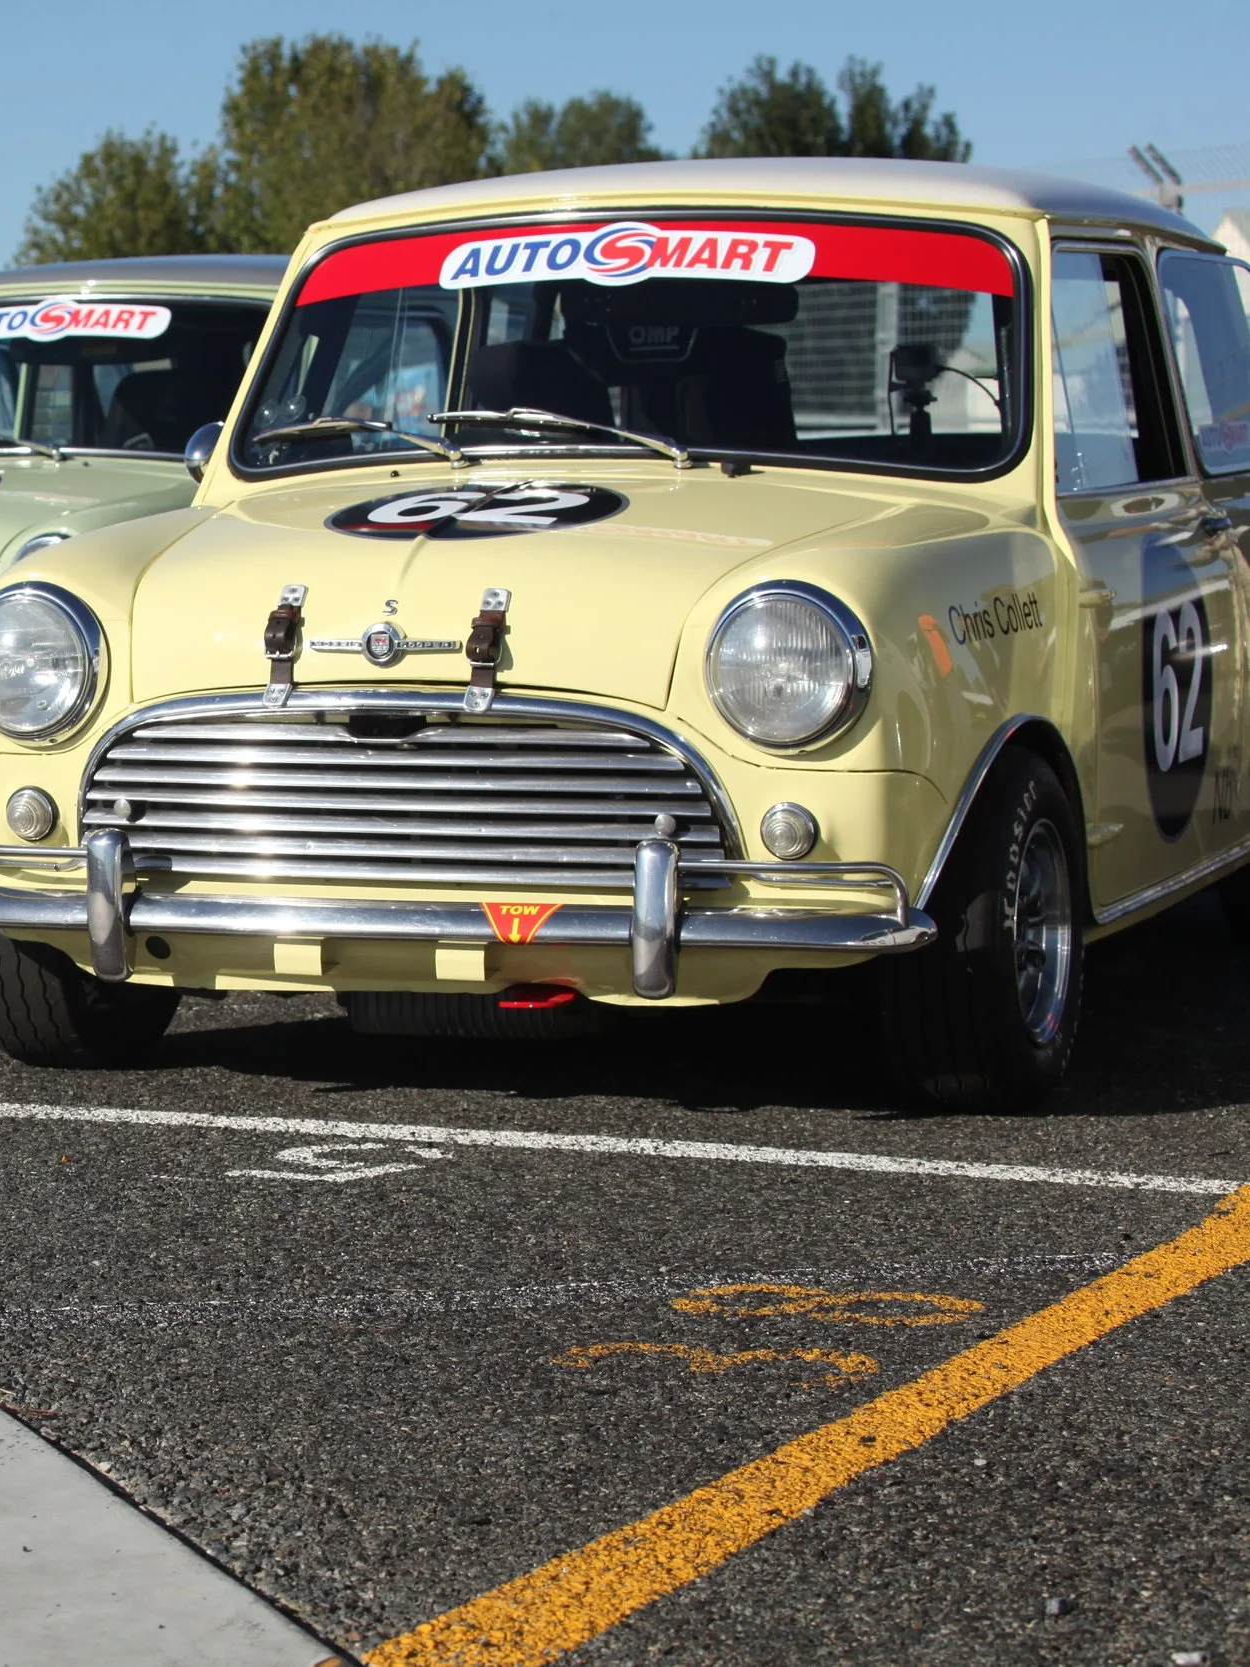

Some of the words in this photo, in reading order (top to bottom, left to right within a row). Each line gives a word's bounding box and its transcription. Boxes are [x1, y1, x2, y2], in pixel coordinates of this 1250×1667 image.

[450, 227, 796, 280] AUTOSMART
[629, 325, 679, 344] OMP
[367, 491, 590, 525] 62
[382, 599, 399, 616] S
[949, 601, 995, 645] Chris
[994, 592, 1043, 635] Collett
[1153, 601, 1203, 772] 62
[500, 905, 541, 916] TOW
